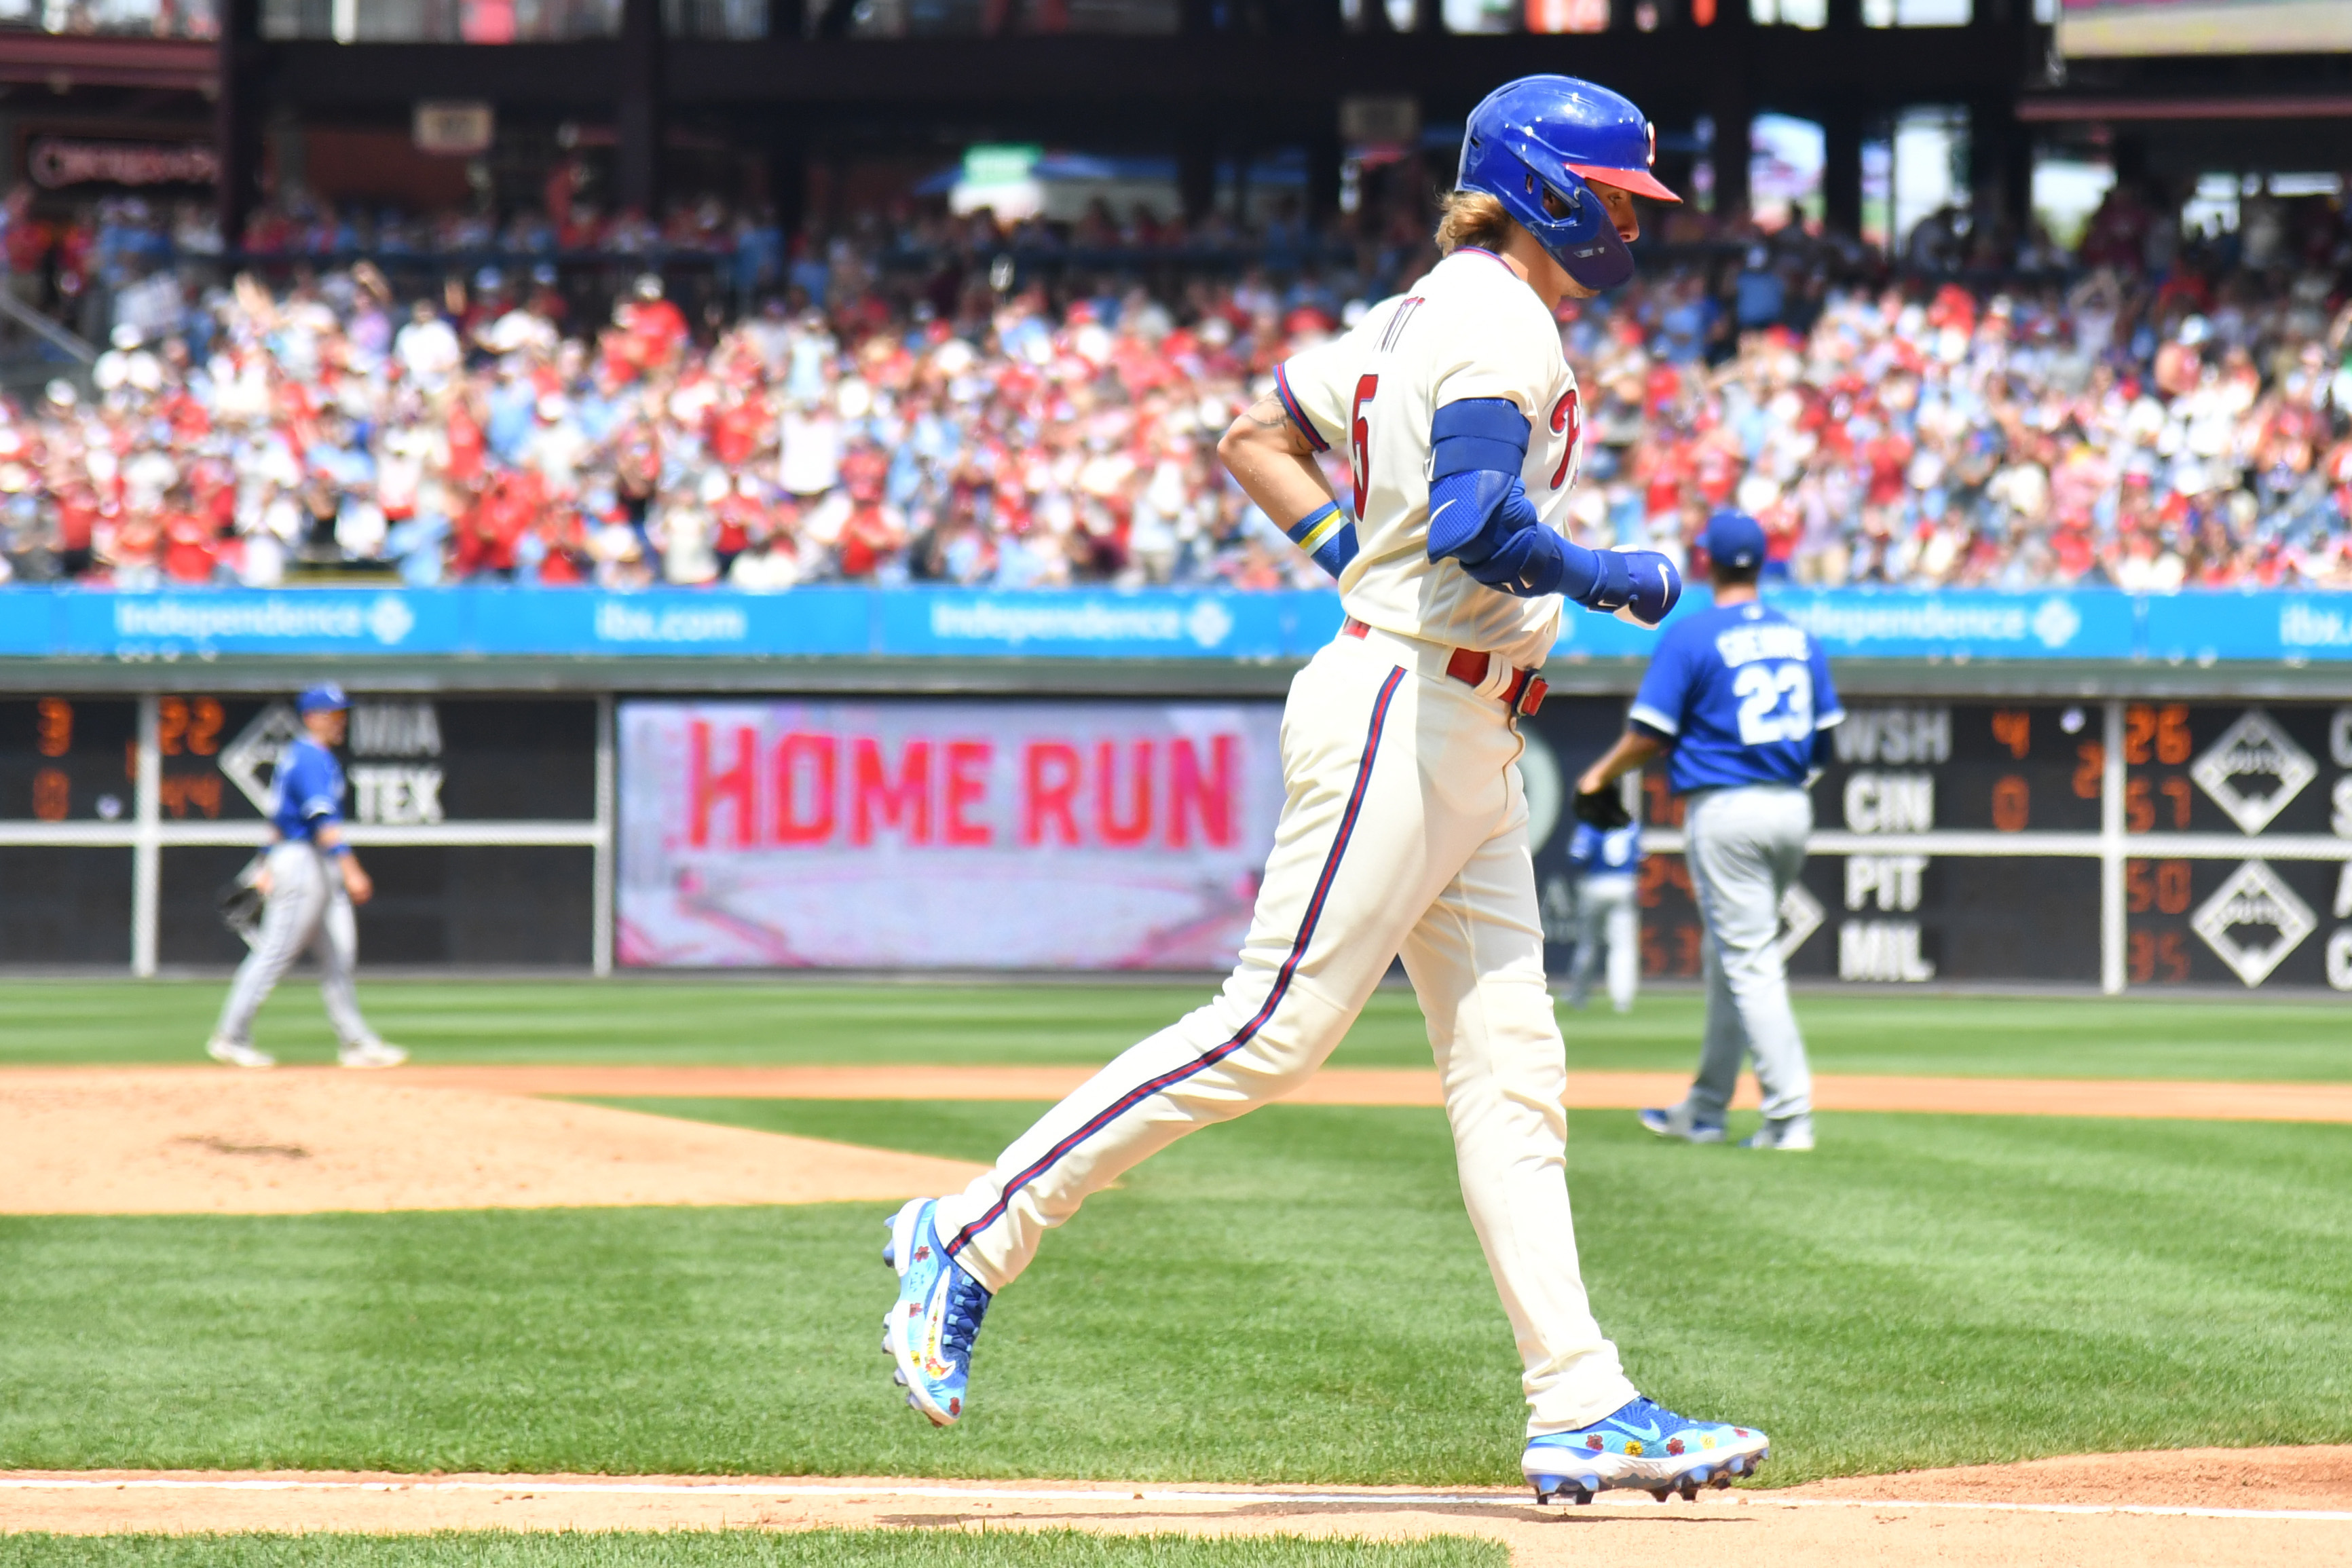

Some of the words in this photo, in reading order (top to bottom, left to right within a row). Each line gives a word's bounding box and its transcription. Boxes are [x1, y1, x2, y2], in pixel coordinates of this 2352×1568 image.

[114, 599, 361, 641] Independence
[930, 601, 1181, 643] Independence
[1734, 665, 1814, 745] 23
[1991, 709, 2030, 760] 4
[2125, 703, 2192, 765] 26
[1834, 708, 1953, 764] WSH
[347, 764, 445, 824] TEX
[688, 720, 992, 848] HOME
[1022, 732, 1241, 848] RUN
[1843, 771, 1935, 833] CIN
[1844, 855, 1929, 911] PIT
[1839, 920, 1935, 982] MIL
